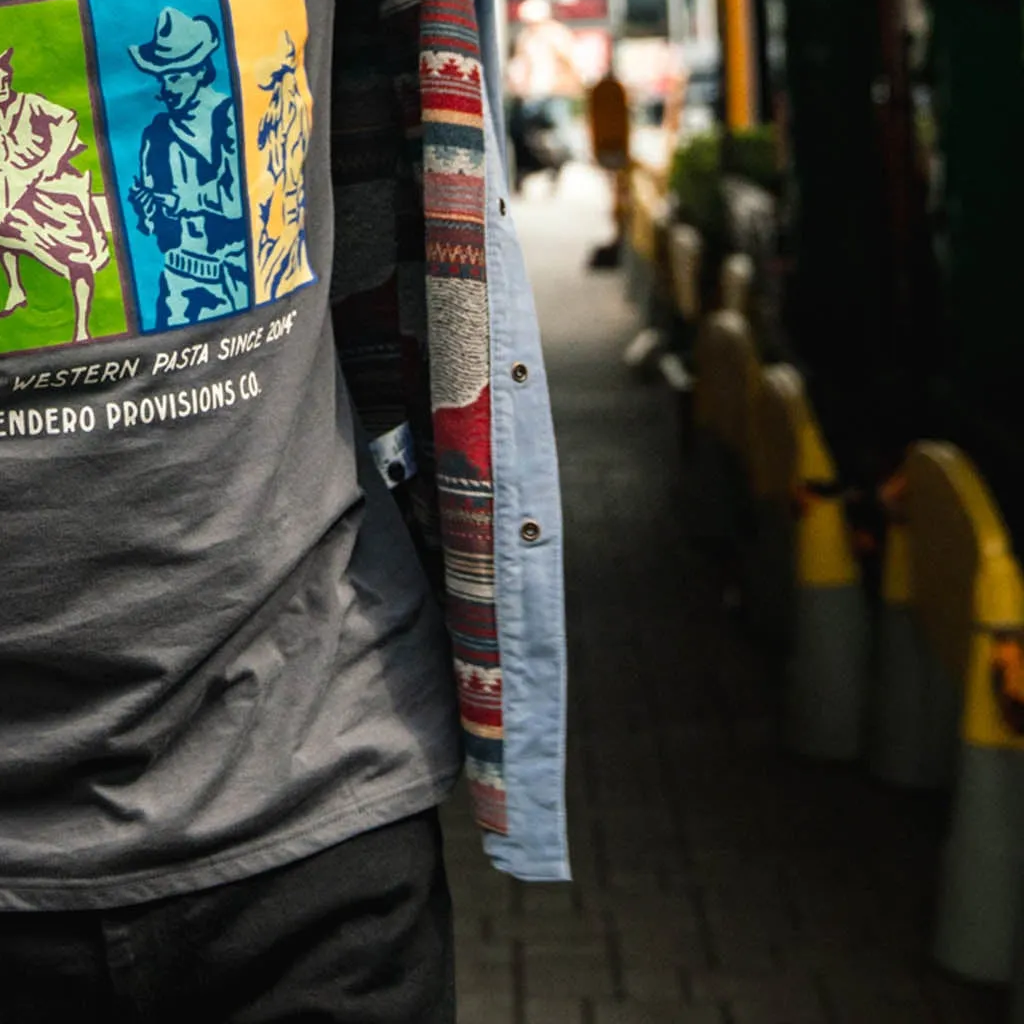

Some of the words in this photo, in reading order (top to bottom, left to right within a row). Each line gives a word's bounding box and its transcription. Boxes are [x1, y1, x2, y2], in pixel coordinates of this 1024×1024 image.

[13, 358, 141, 392] WESTERN
[152, 343, 210, 376] PASTA
[218, 327, 264, 360] SINCE
[107, 379, 236, 430] PROVISIONS
[239, 370, 263, 400] CO.
